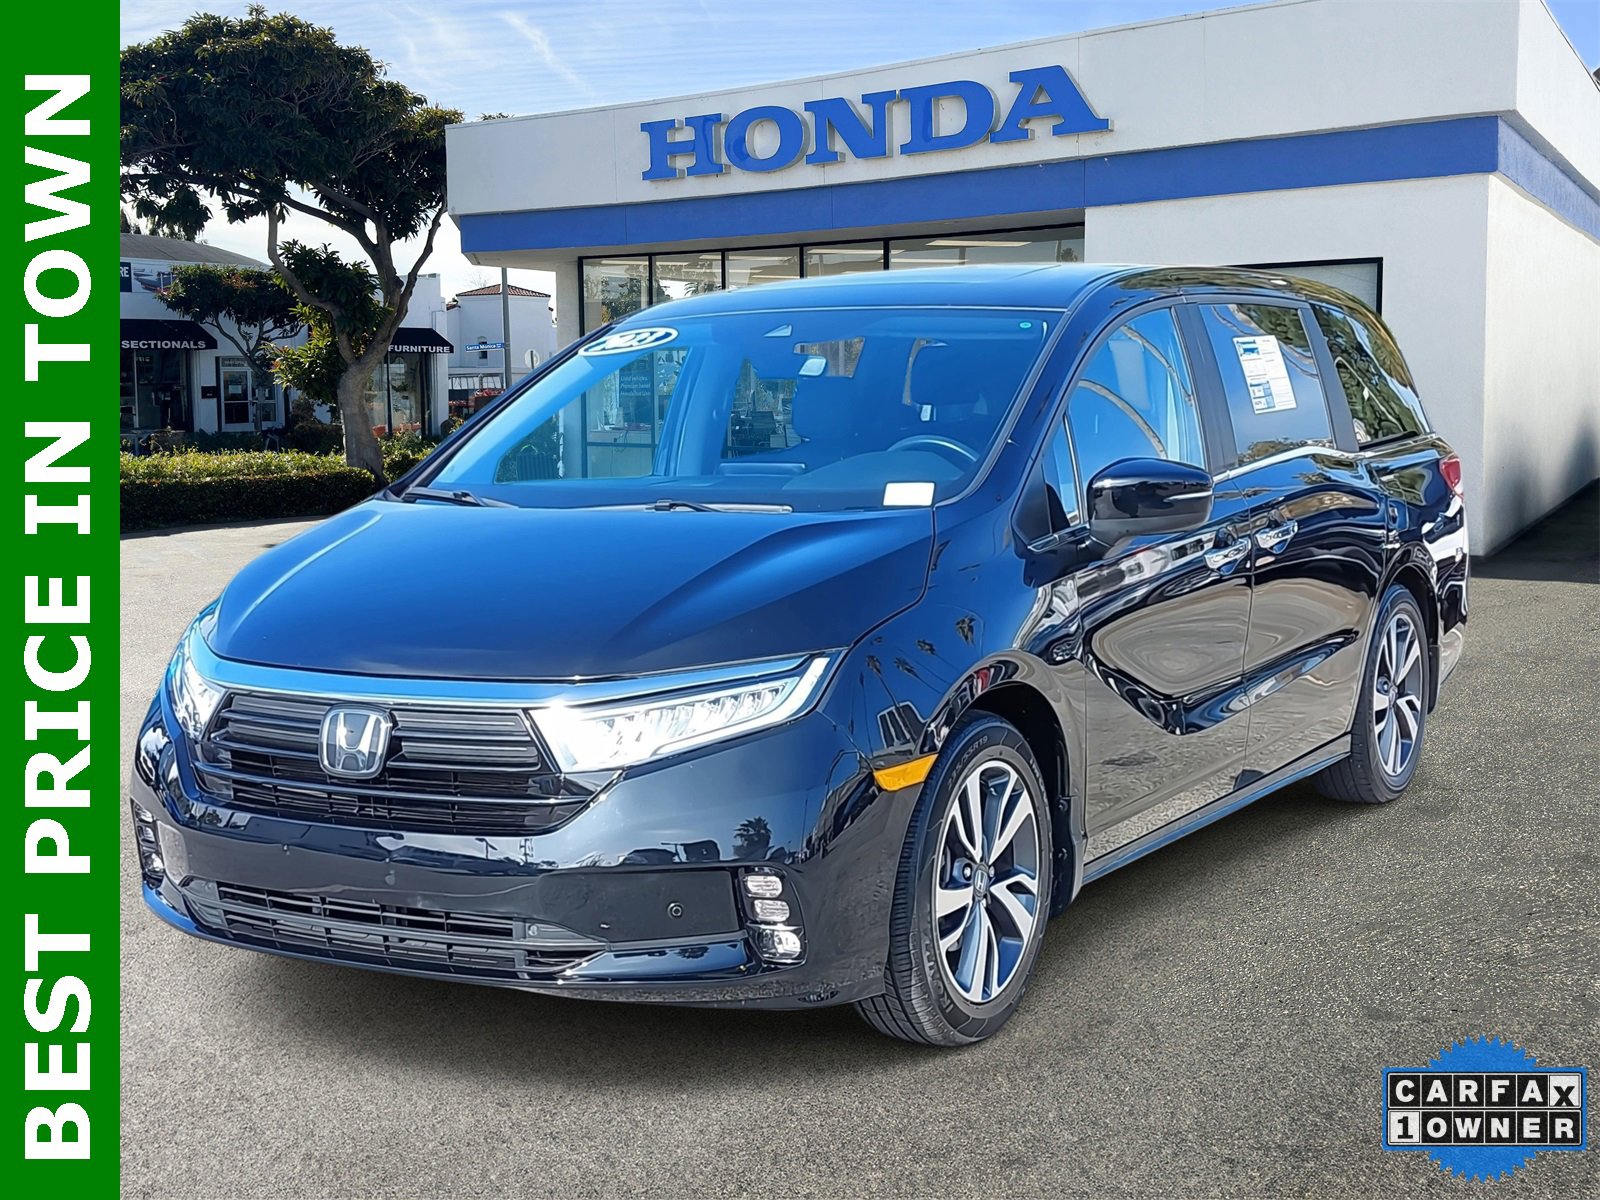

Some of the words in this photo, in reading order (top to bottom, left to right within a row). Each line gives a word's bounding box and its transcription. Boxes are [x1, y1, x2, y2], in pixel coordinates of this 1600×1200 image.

[640, 64, 1113, 182] HONDA
[121, 340, 206, 349] SECTIONALS
[388, 344, 450, 353] FURNITURE
